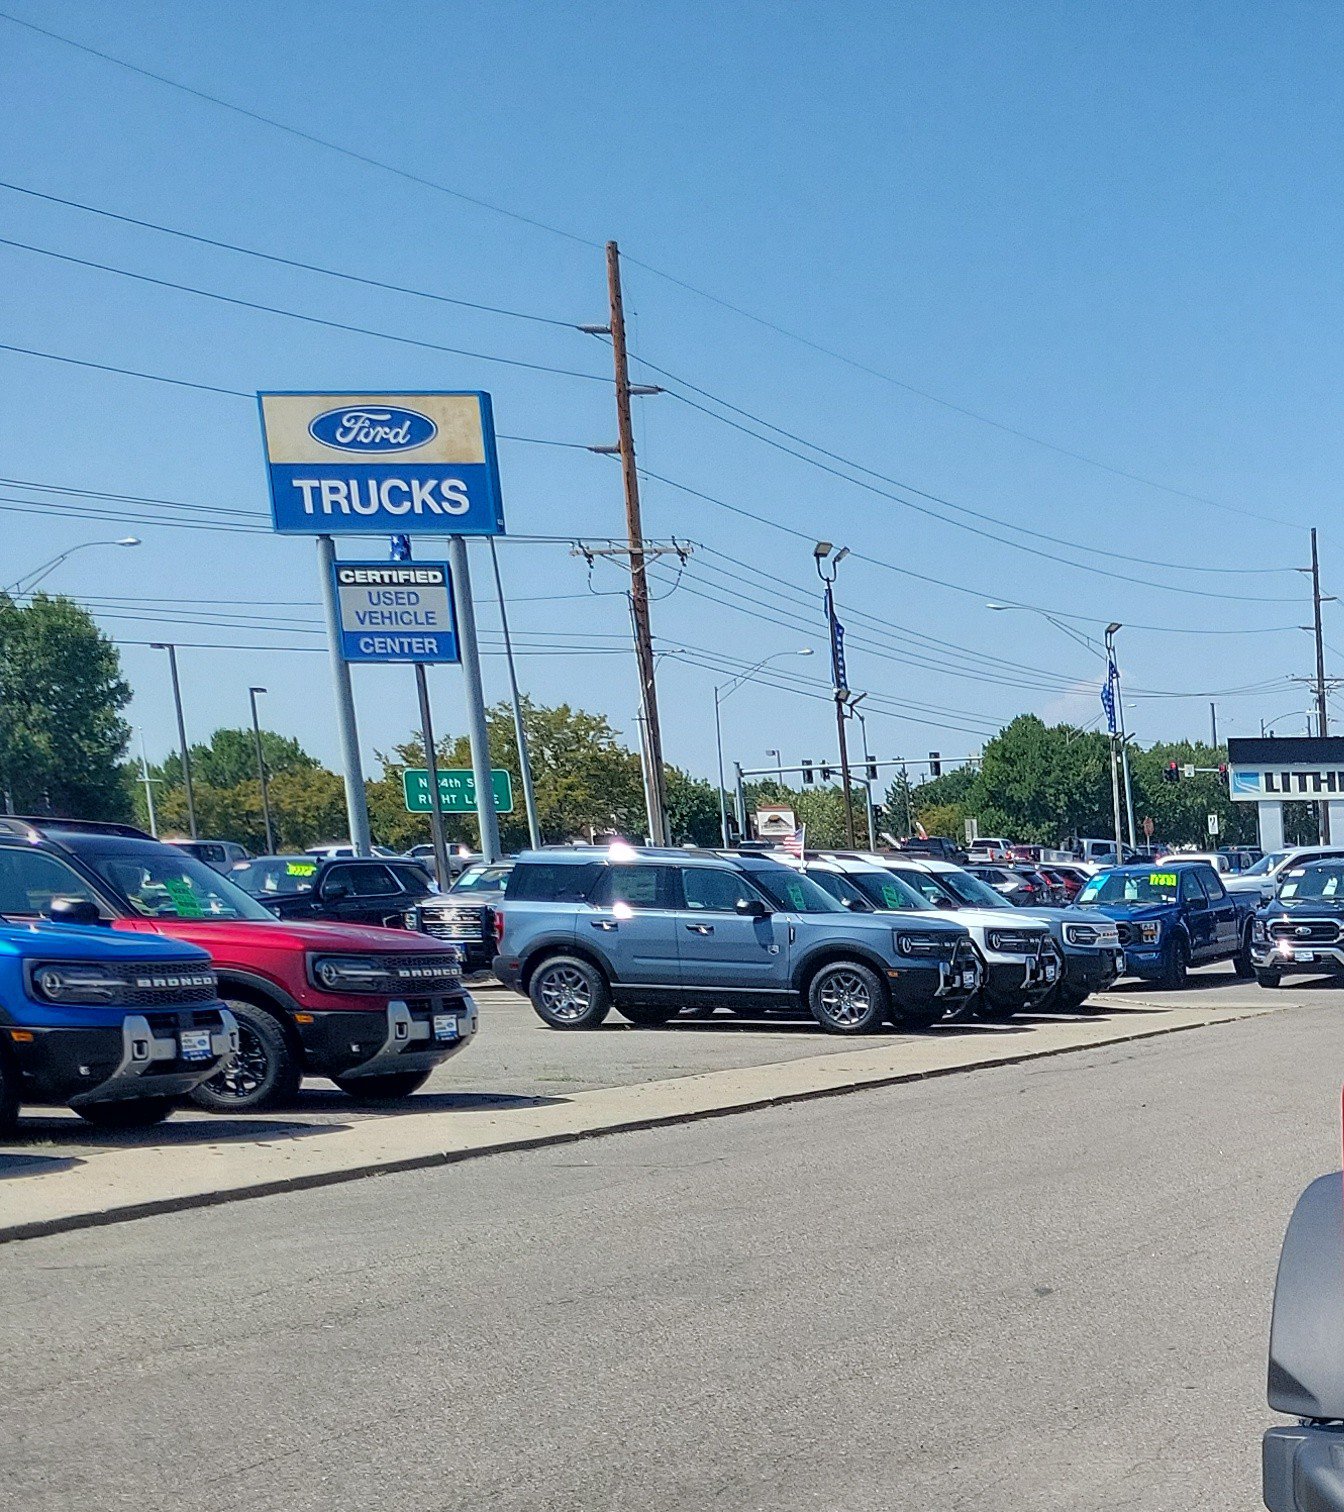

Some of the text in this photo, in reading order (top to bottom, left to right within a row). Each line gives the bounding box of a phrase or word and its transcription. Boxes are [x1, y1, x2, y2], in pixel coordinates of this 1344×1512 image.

[335, 411, 411, 444] Ford
[293, 478, 470, 515] TRUCKS
[339, 569, 443, 584] CERTIFIED
[368, 591, 420, 606] USED
[356, 610, 437, 626] VEHICLE
[359, 637, 438, 654] CENTER
[418, 778, 428, 788] N
[418, 794, 457, 805] RIHT
[398, 968, 458, 977] BRONCO
[137, 977, 212, 987] BRONCO
